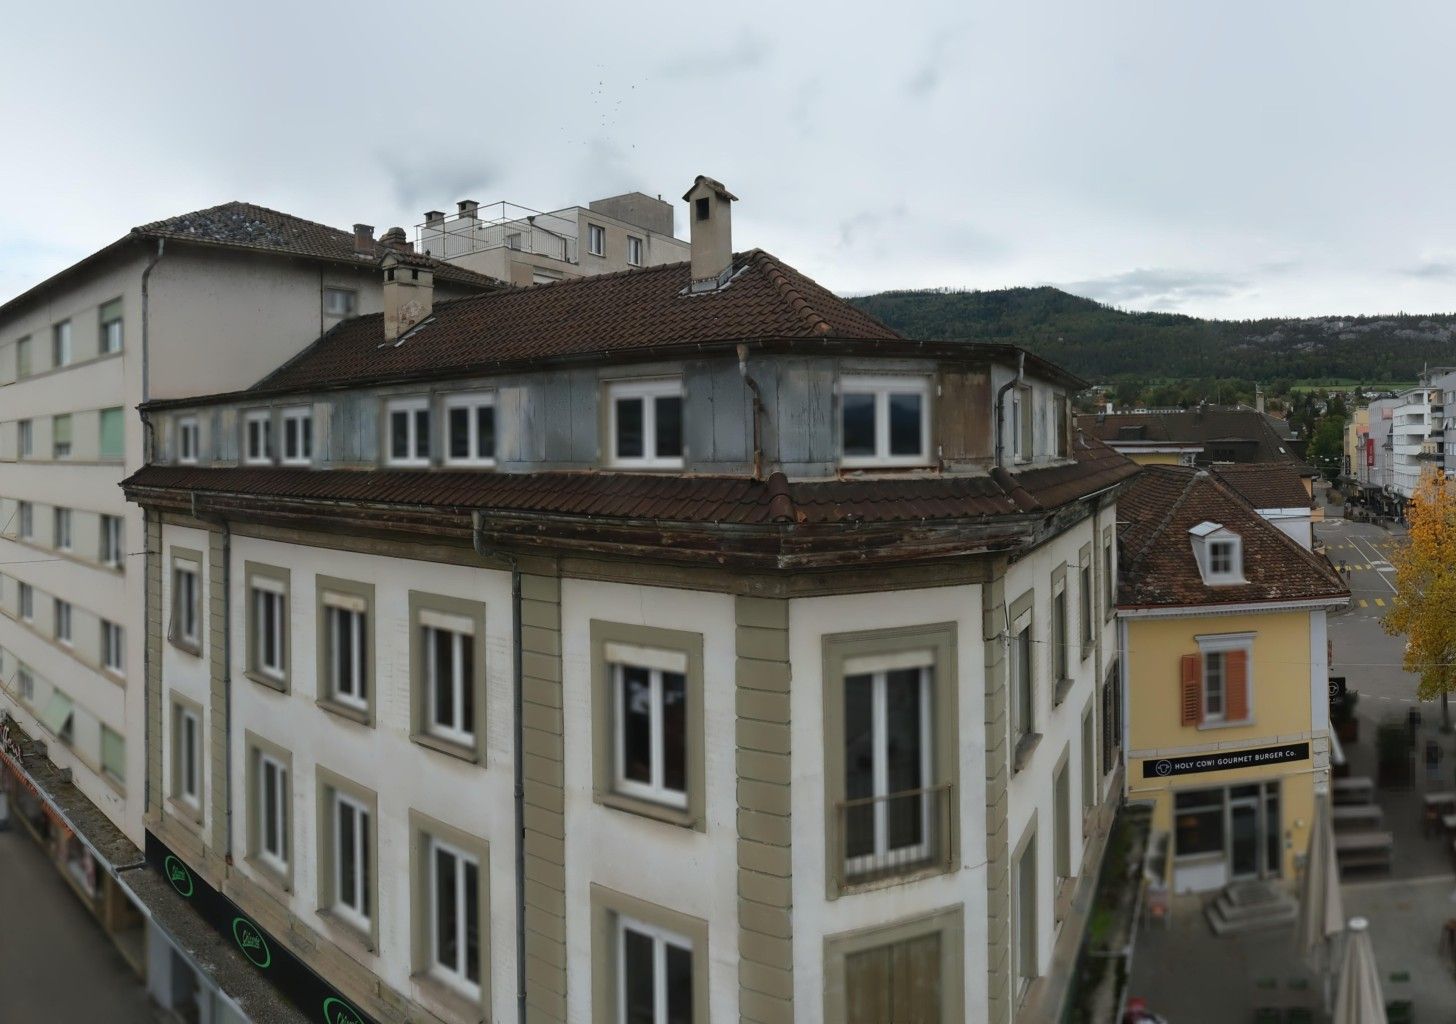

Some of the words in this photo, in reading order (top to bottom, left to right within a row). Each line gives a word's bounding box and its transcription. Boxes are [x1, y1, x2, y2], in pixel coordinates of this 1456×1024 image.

[1174, 761, 1194, 770] HOLY
[1217, 755, 1252, 766] GOURMET
[1254, 751, 1283, 761] BURGER
